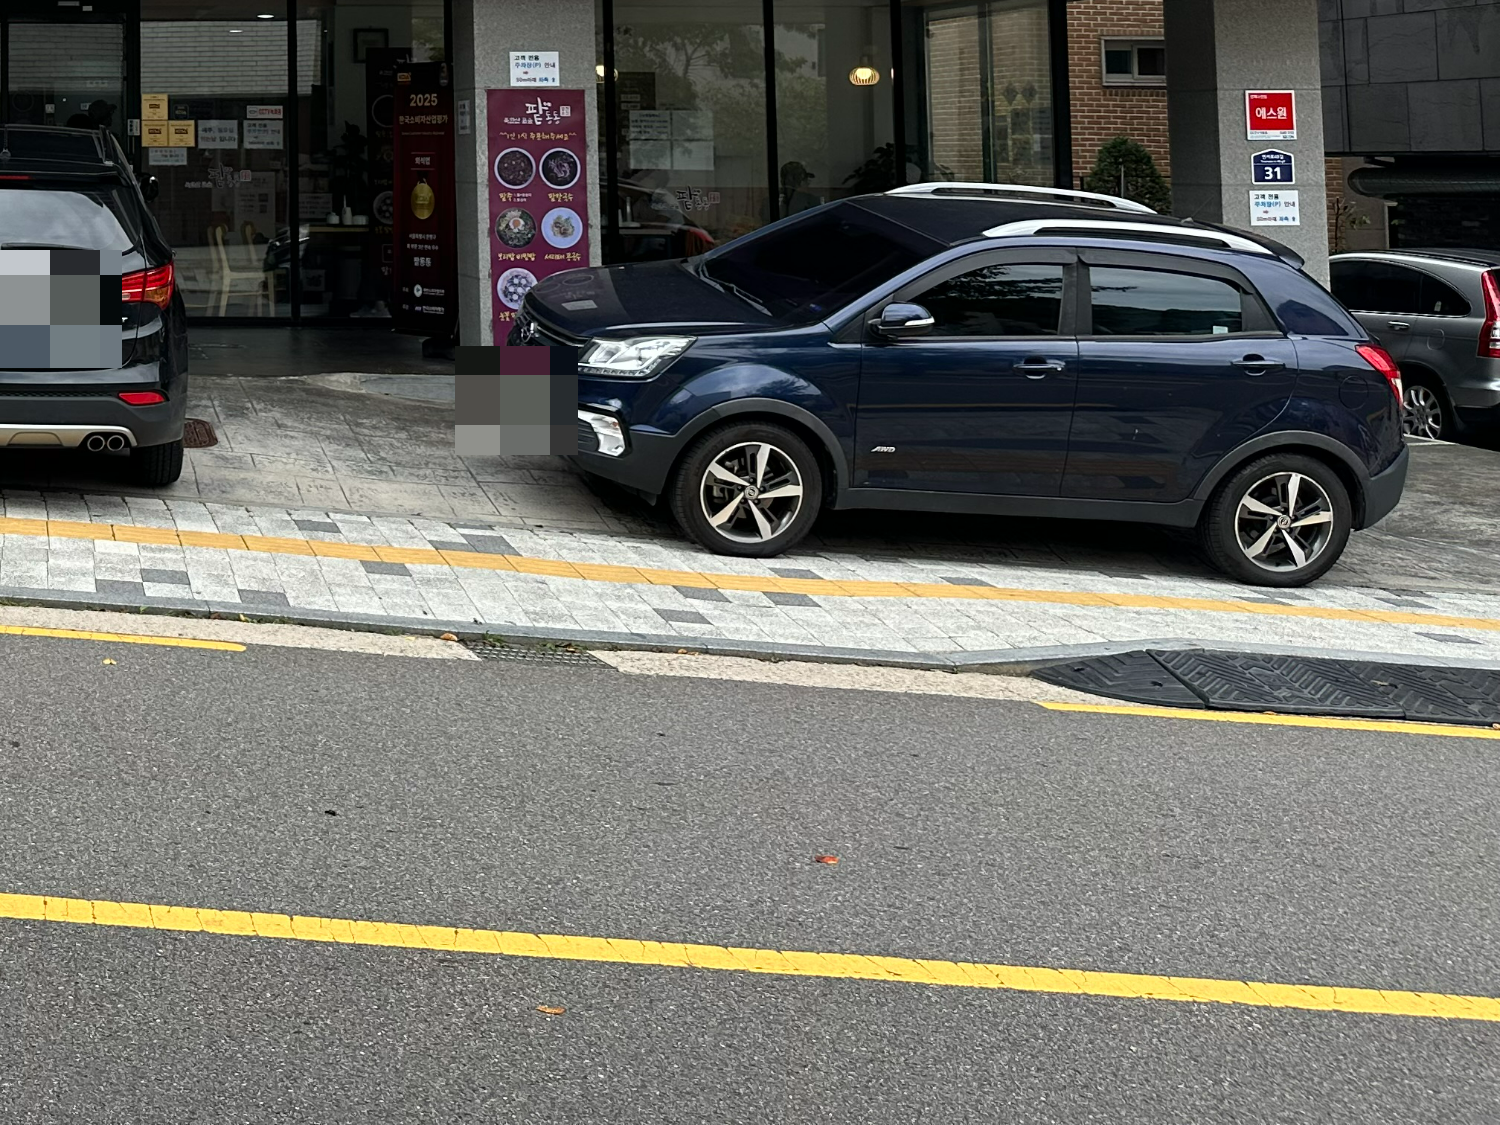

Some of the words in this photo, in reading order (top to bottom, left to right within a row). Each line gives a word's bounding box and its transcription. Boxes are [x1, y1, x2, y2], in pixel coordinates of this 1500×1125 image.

[409, 93, 438, 107] 2025
[525, 96, 561, 125] 팥동동
[1255, 106, 1287, 120] 에스원
[1264, 167, 1281, 180] 31
